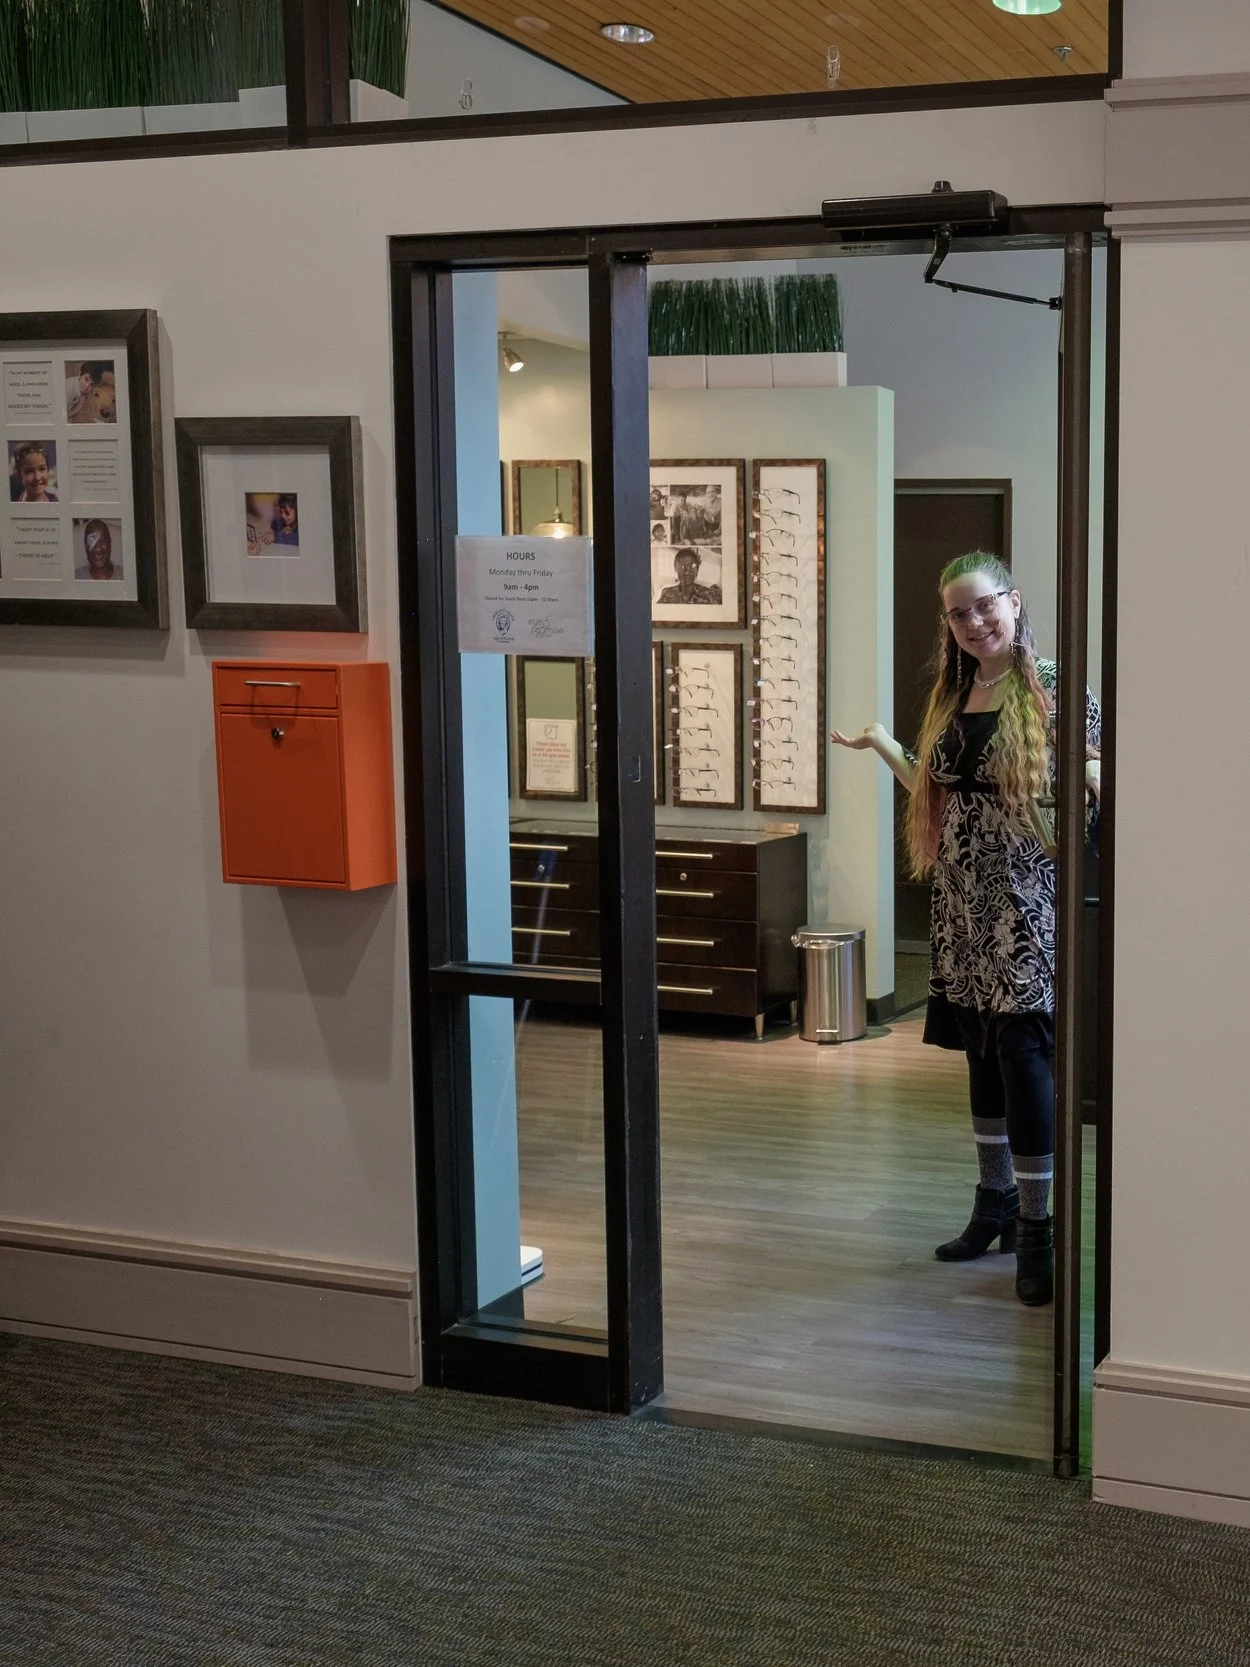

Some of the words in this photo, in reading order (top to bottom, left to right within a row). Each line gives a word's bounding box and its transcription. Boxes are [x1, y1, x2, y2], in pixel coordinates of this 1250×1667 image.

[506, 552, 536, 560] HOURS
[489, 568, 516, 576] Monday
[533, 569, 553, 577] Friday
[503, 583, 519, 591] 9am
[524, 583, 540, 592] 4pm
